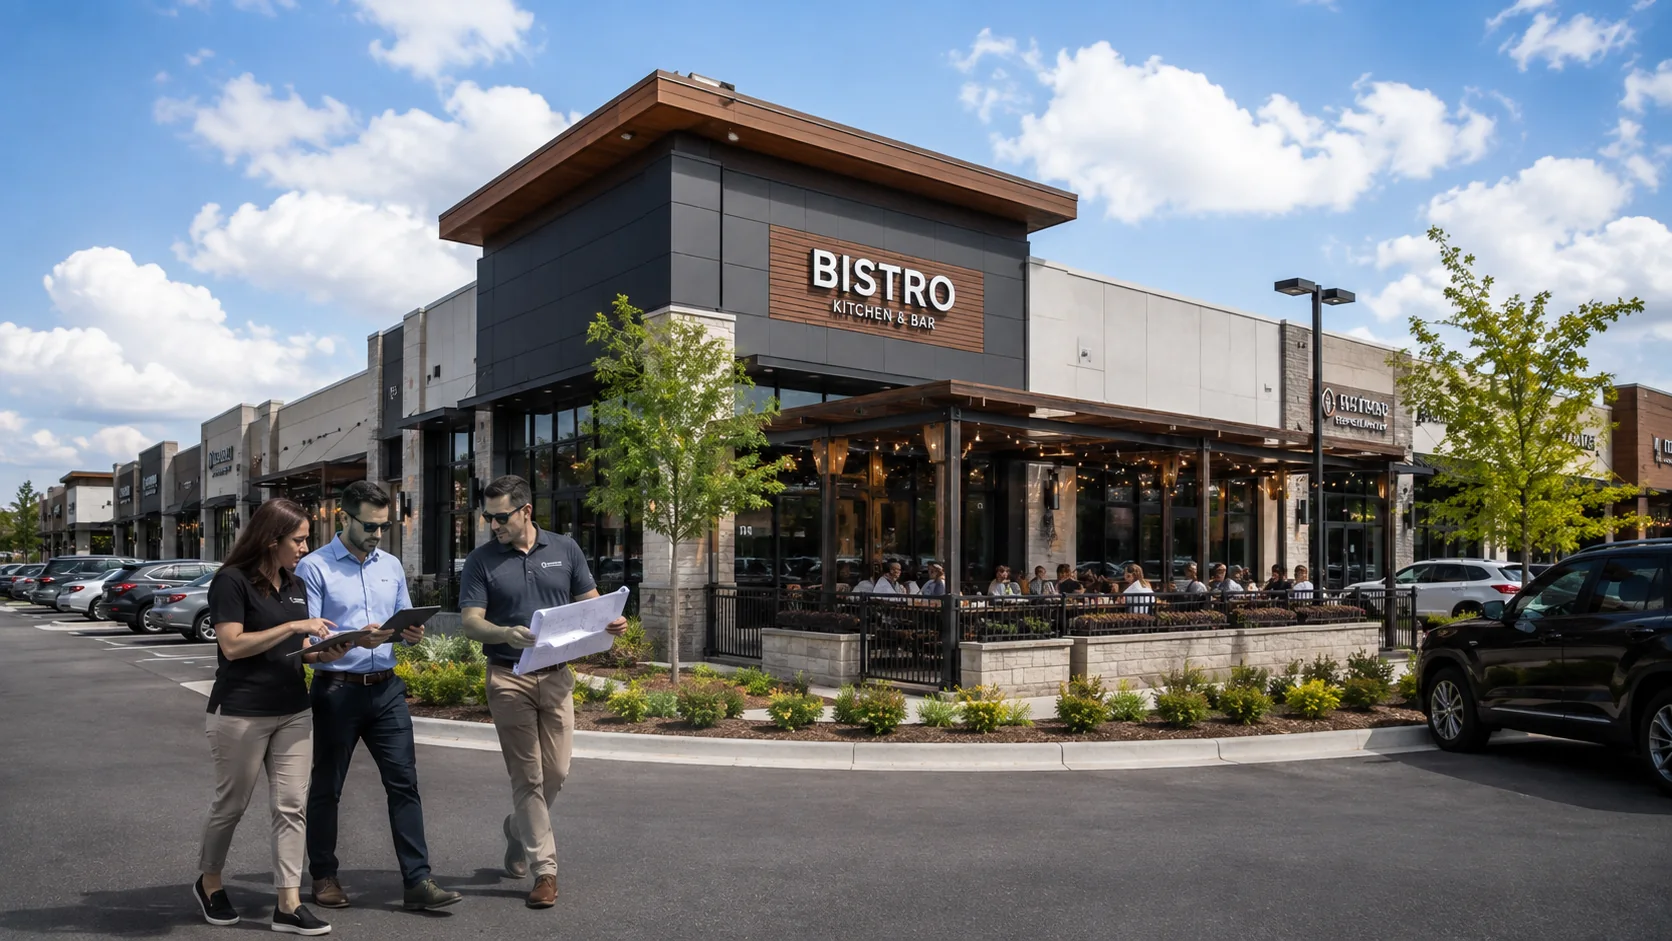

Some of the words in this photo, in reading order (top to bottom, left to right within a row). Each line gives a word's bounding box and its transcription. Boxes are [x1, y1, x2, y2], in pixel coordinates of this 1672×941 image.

[812, 248, 956, 312] BISTRO
[832, 299, 892, 322] KITCHEN
[897, 311, 905, 324] &
[911, 313, 936, 330] BAR
